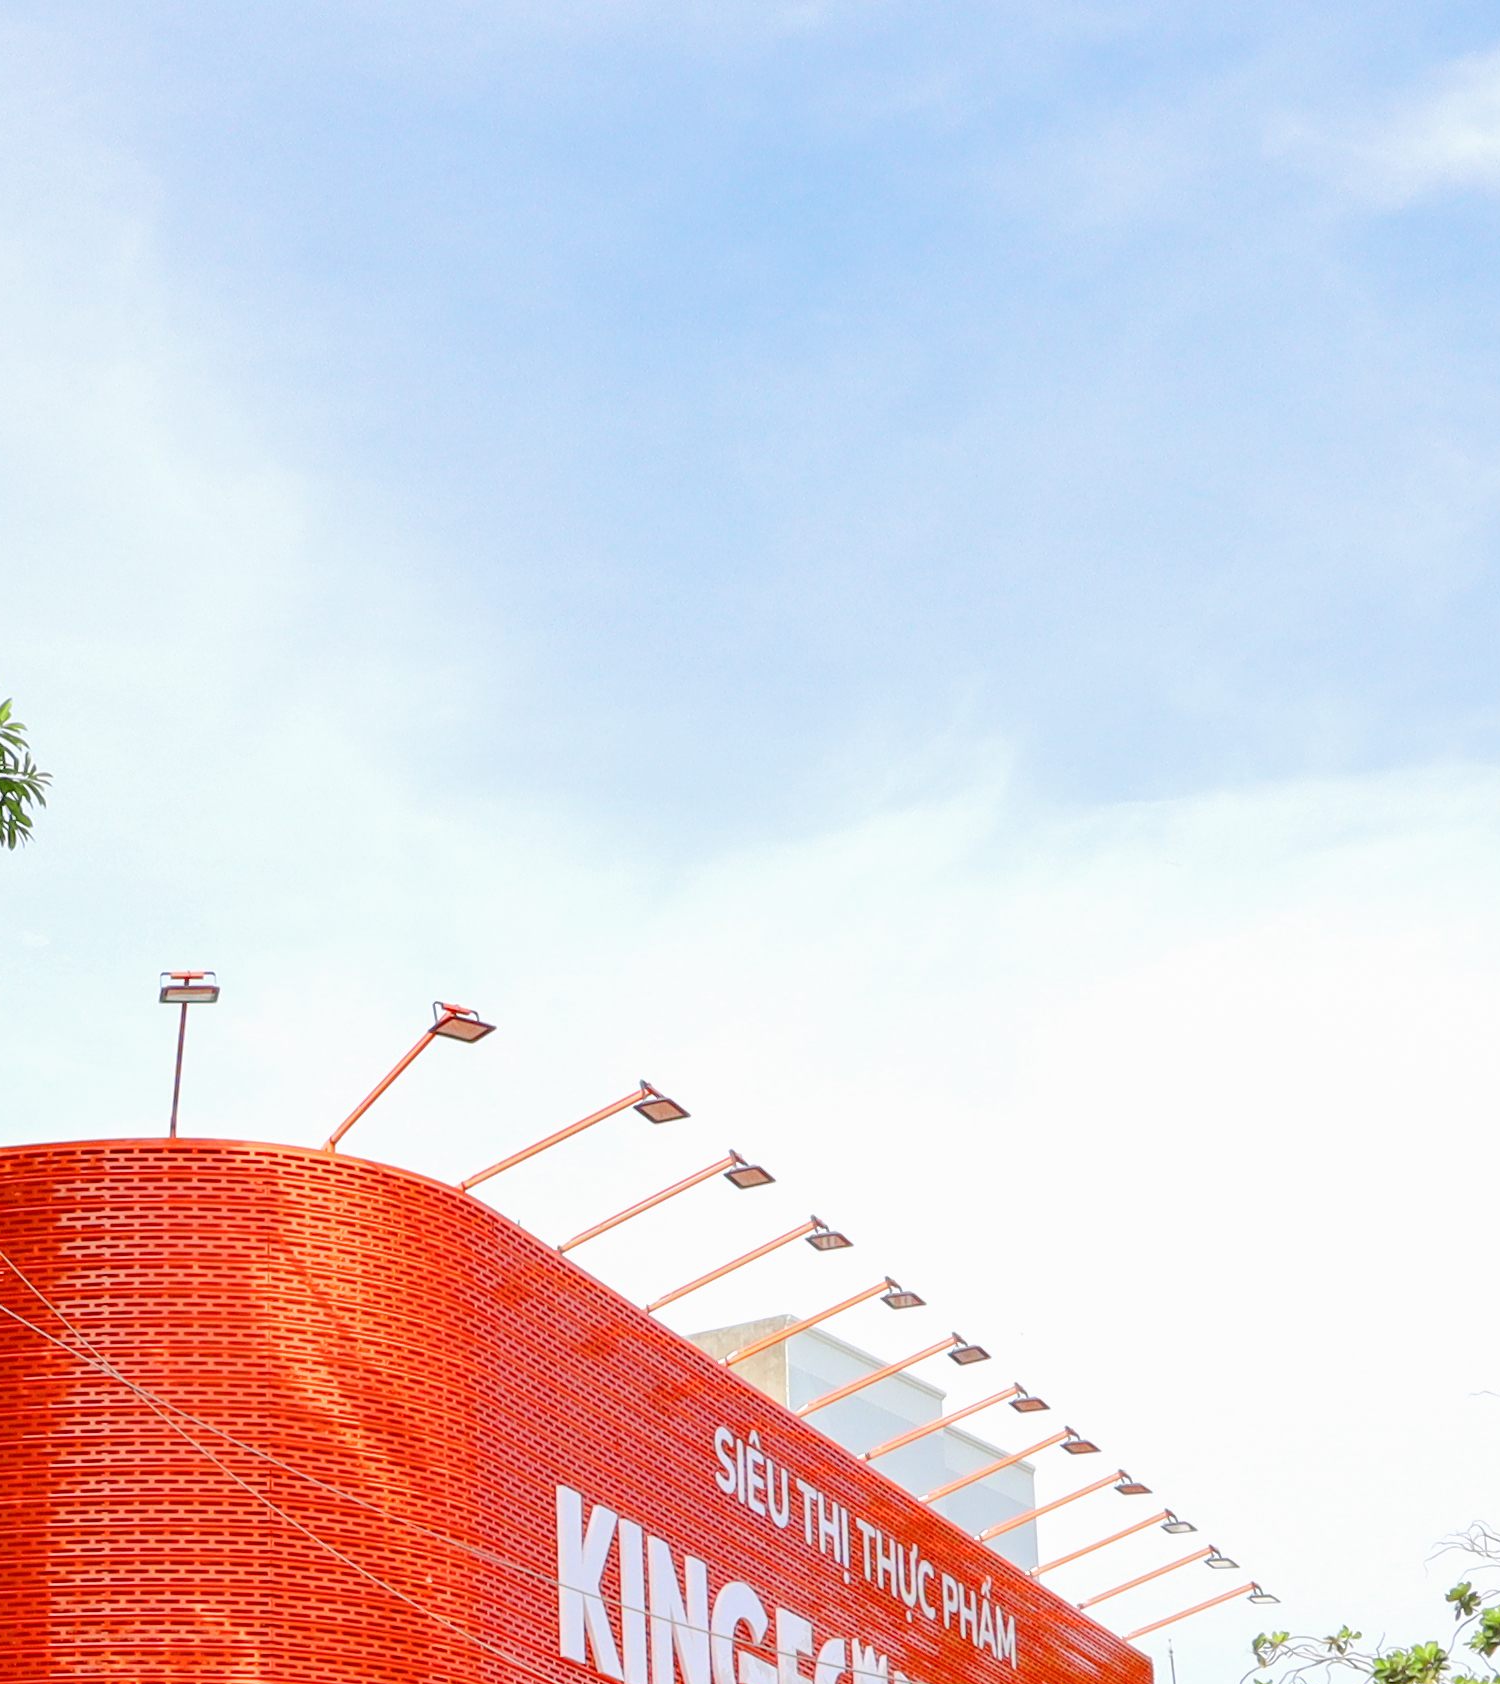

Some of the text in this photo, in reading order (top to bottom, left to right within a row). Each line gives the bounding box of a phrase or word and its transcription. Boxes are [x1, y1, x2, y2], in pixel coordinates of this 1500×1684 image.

[714, 1425, 1017, 1670] SIÊU THỊ THỰC PHẨM
